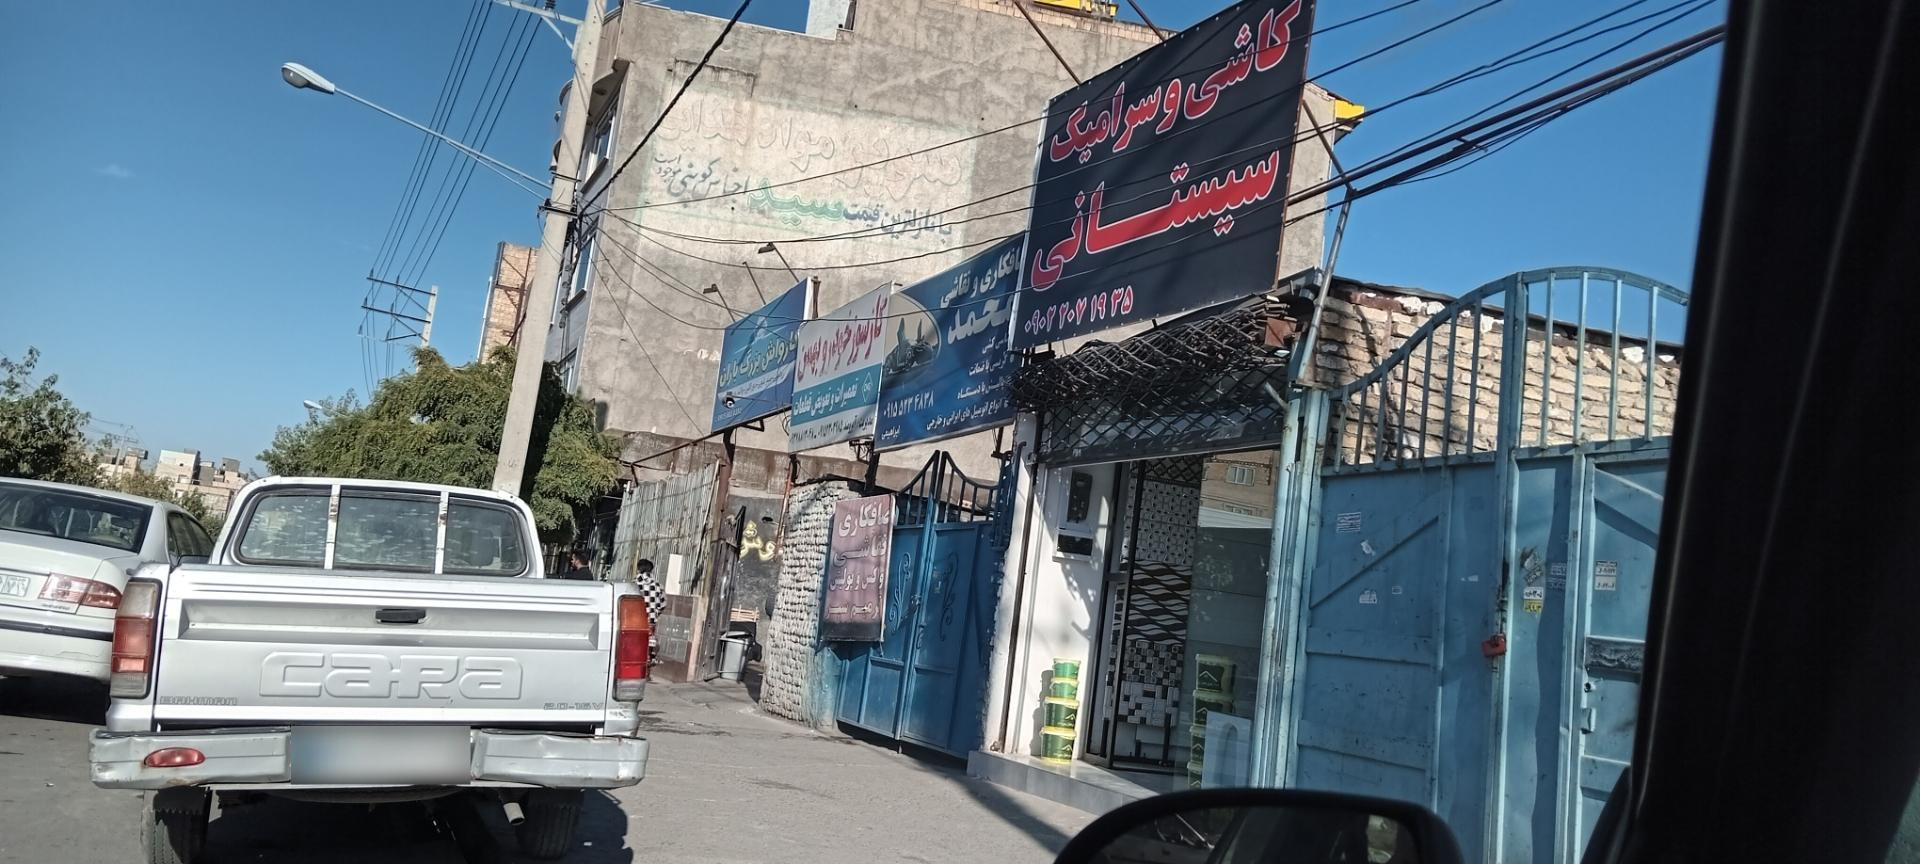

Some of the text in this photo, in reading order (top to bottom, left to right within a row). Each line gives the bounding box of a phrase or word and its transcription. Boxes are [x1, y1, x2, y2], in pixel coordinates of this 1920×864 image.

[1050, 0, 1301, 163] کاشی و سرامیک
[842, 203, 884, 228] قیمت
[1031, 150, 1280, 291] سیستانی
[940, 246, 1020, 309] افکاری و نقاشی
[1111, 285, 1134, 318] ۳۵
[839, 501, 890, 537] صافکاری
